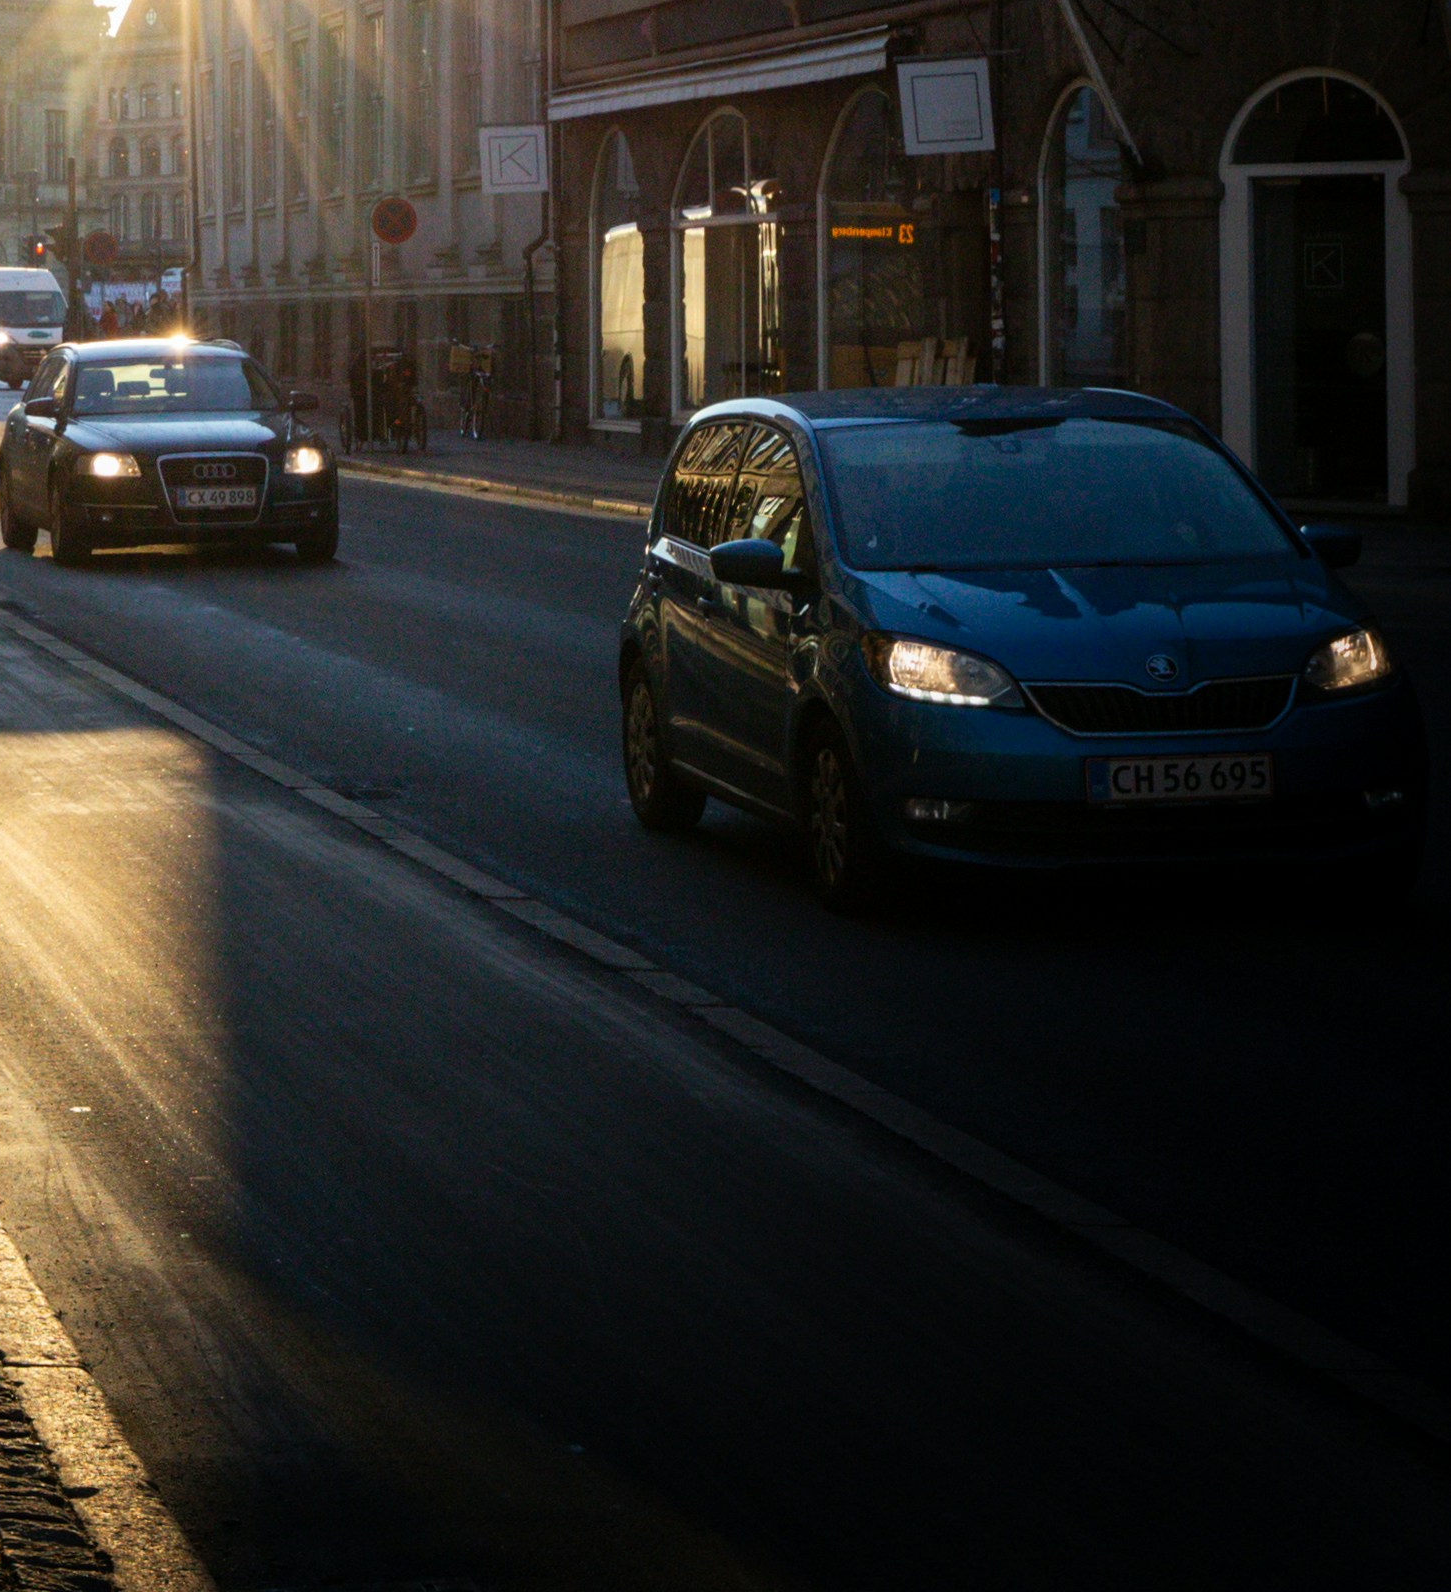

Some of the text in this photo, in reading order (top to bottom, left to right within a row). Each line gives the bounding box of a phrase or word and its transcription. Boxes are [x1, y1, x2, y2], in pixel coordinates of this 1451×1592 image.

[498, 140, 533, 178] K
[188, 490, 254, 504] CX 49 898
[1112, 760, 1267, 794] CH 56 695
